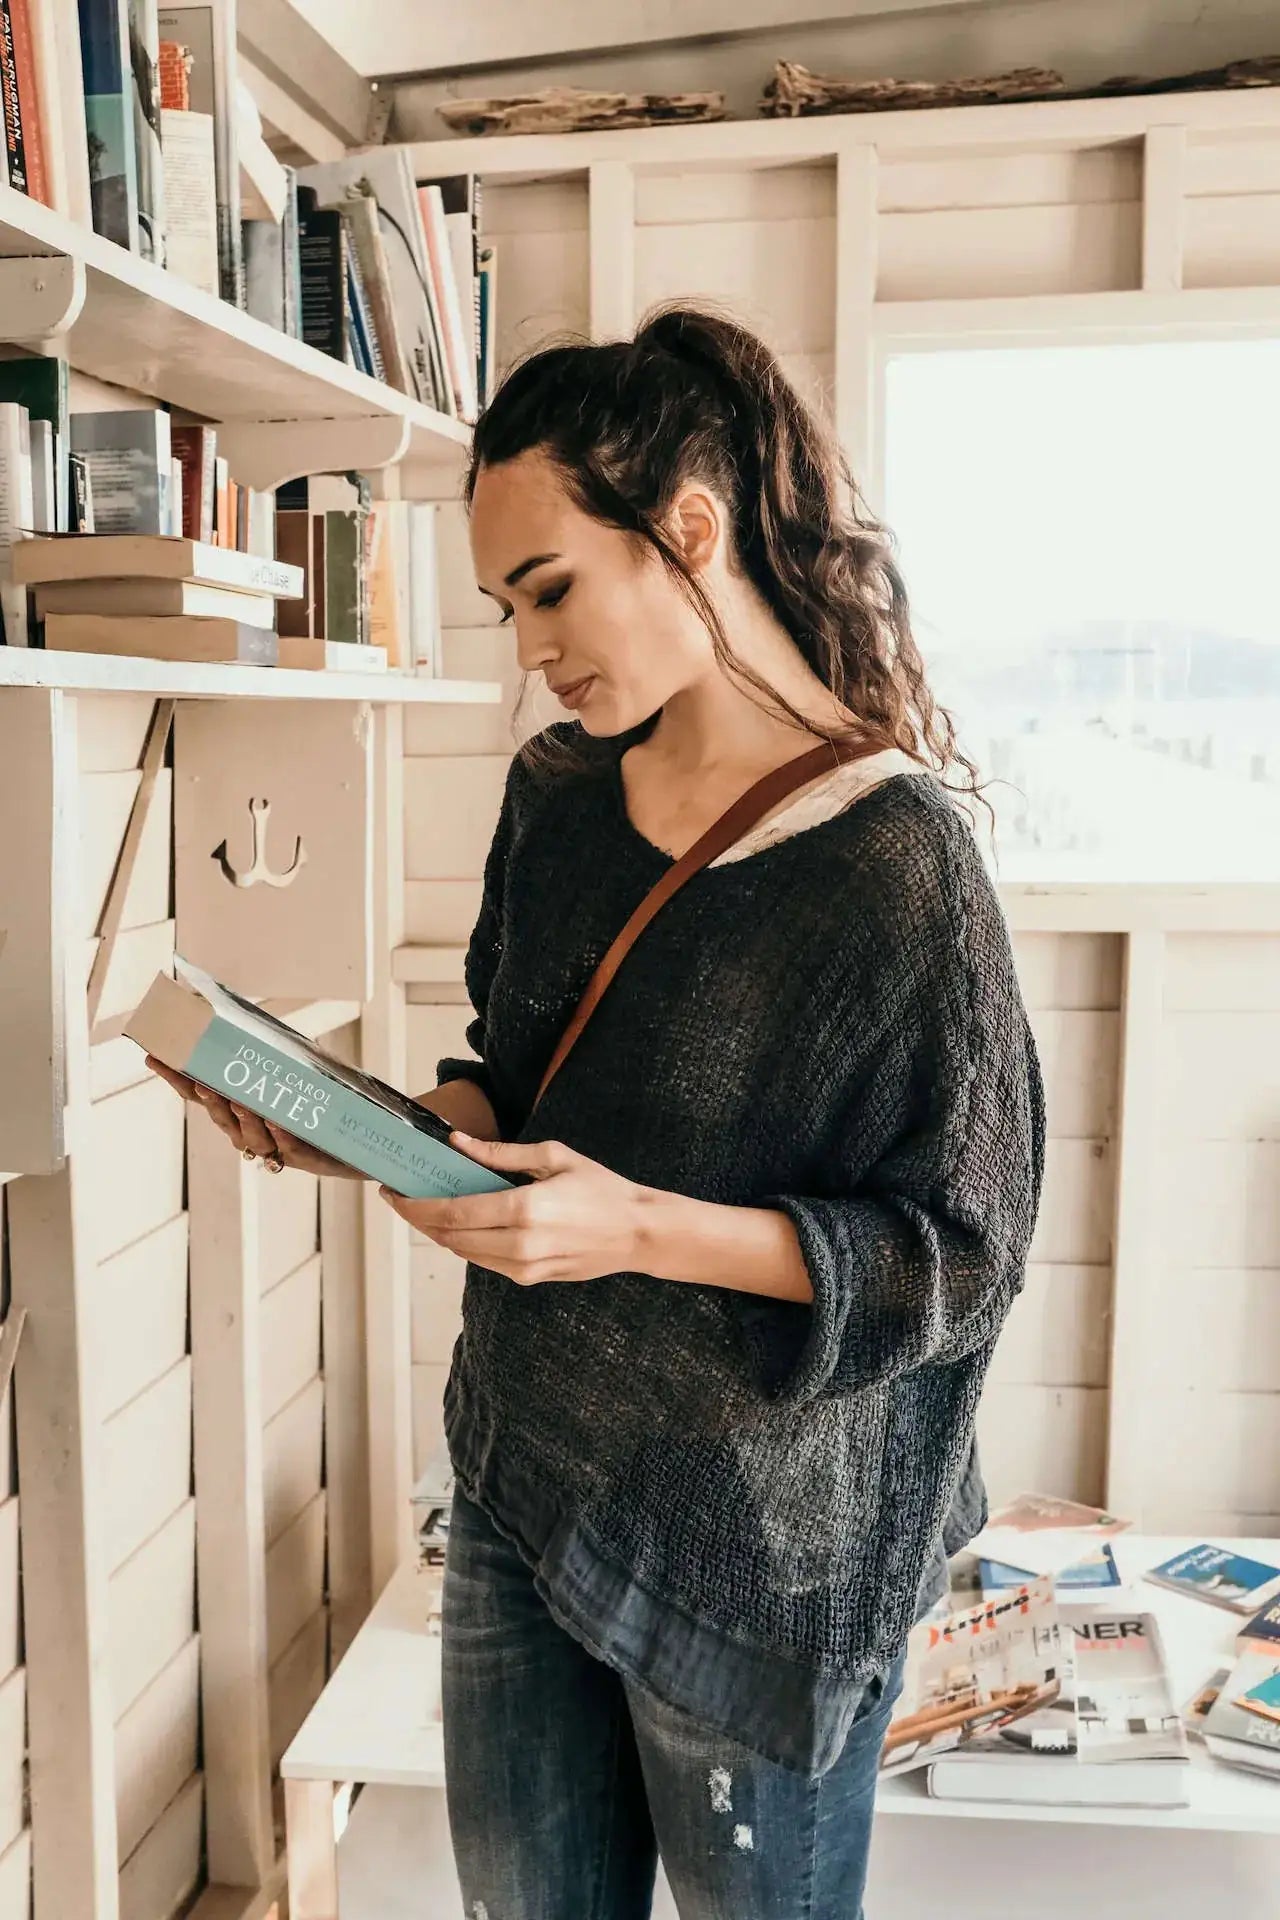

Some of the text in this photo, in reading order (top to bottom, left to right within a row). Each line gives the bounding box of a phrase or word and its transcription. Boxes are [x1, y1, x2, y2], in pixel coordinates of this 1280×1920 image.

[3, 13, 22, 140] PAUL KRUGMAN
[223, 1060, 326, 1130] OATES
[235, 1044, 331, 1106] JOYCE CAROL
[430, 1165, 464, 1190] LOVE
[943, 1594, 1030, 1636] LIVING
